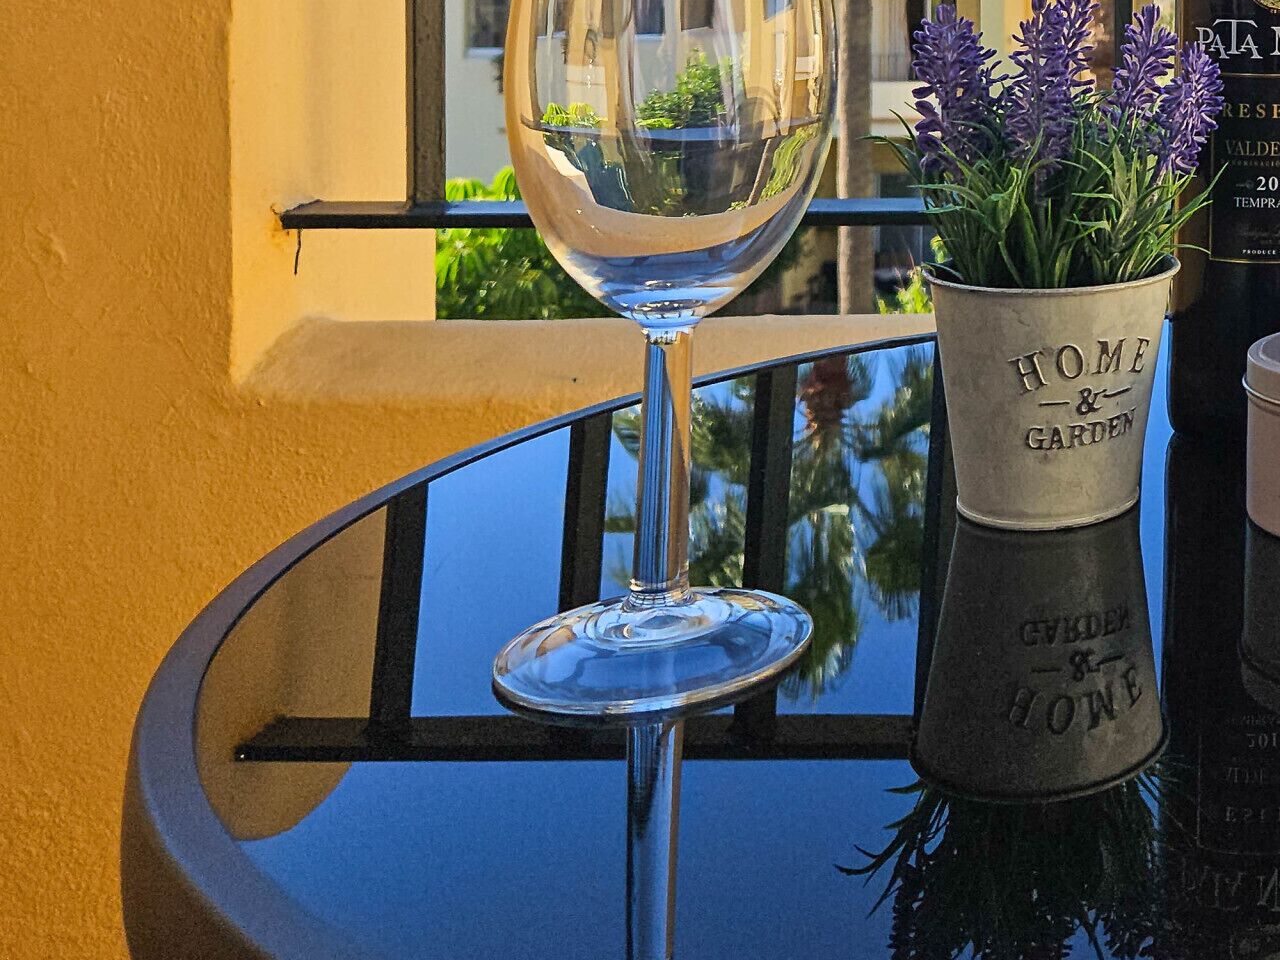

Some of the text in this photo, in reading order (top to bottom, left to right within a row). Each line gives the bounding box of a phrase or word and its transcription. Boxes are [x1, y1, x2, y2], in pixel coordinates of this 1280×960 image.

[1195, 18, 1263, 59] PATA
[1007, 336, 1151, 395] HOME
[1075, 385, 1108, 416] &
[1024, 407, 1137, 451] GARDEN
